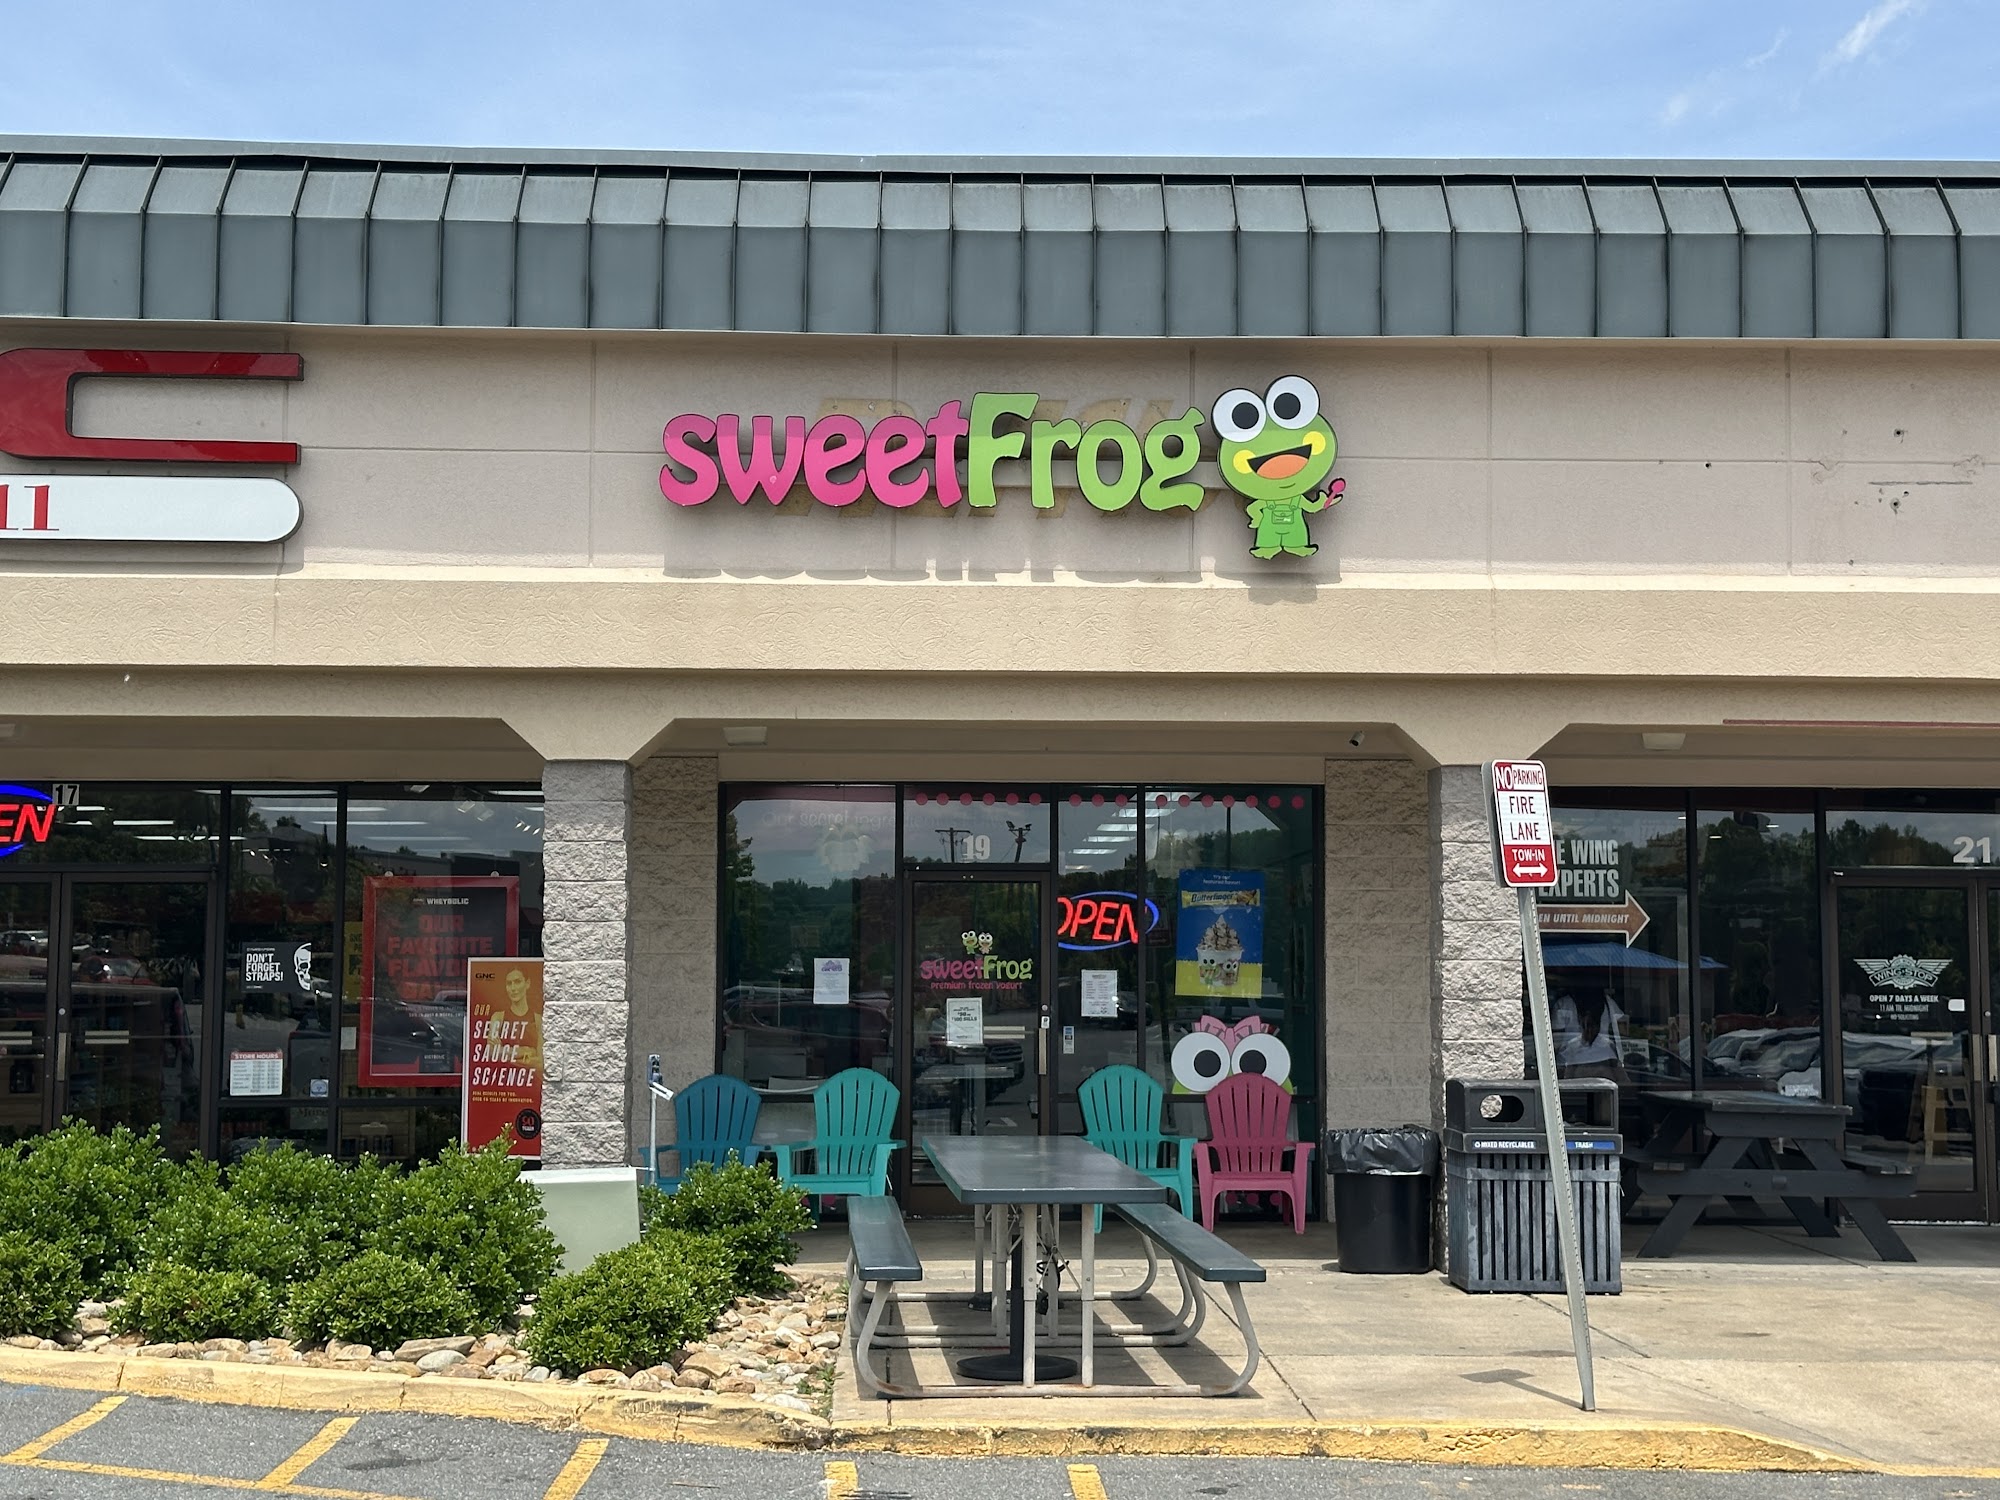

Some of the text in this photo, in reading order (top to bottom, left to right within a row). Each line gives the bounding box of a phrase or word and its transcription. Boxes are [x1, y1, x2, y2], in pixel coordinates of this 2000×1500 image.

[659, 392, 1206, 511] sweetFrog
[1494, 766, 1543, 790] NO PARKING
[55, 784, 78, 805] 17
[1509, 795, 1536, 815] FIRE
[1509, 822, 1542, 841] LANE
[962, 834, 991, 861] 19
[1511, 848, 1546, 862] TOW-IN
[1555, 839, 1619, 865] E WING
[1952, 836, 1991, 864] 21
[1191, 892, 1234, 903] Butterfinger
[419, 914, 464, 932] OUR
[1553, 913, 1580, 923] UNTIL
[1582, 914, 1629, 923] MIDNIGHT
[387, 936, 493, 955] FAVORITE
[245, 962, 280, 972] FORGET
[246, 953, 274, 963] DON'T
[245, 971, 284, 981] STRAPS!
[387, 959, 468, 977] FLAVO
[920, 955, 1033, 980] sweetFrog
[930, 980, 1023, 990] premium frozen yogurt
[1869, 994, 1939, 1003] OPEN 7 DAYS A WEEK
[474, 1004, 491, 1016] OUR
[473, 1020, 529, 1040] SECRET
[473, 1043, 520, 1063] SAUCE
[1574, 1141, 1594, 1149] TRASH
